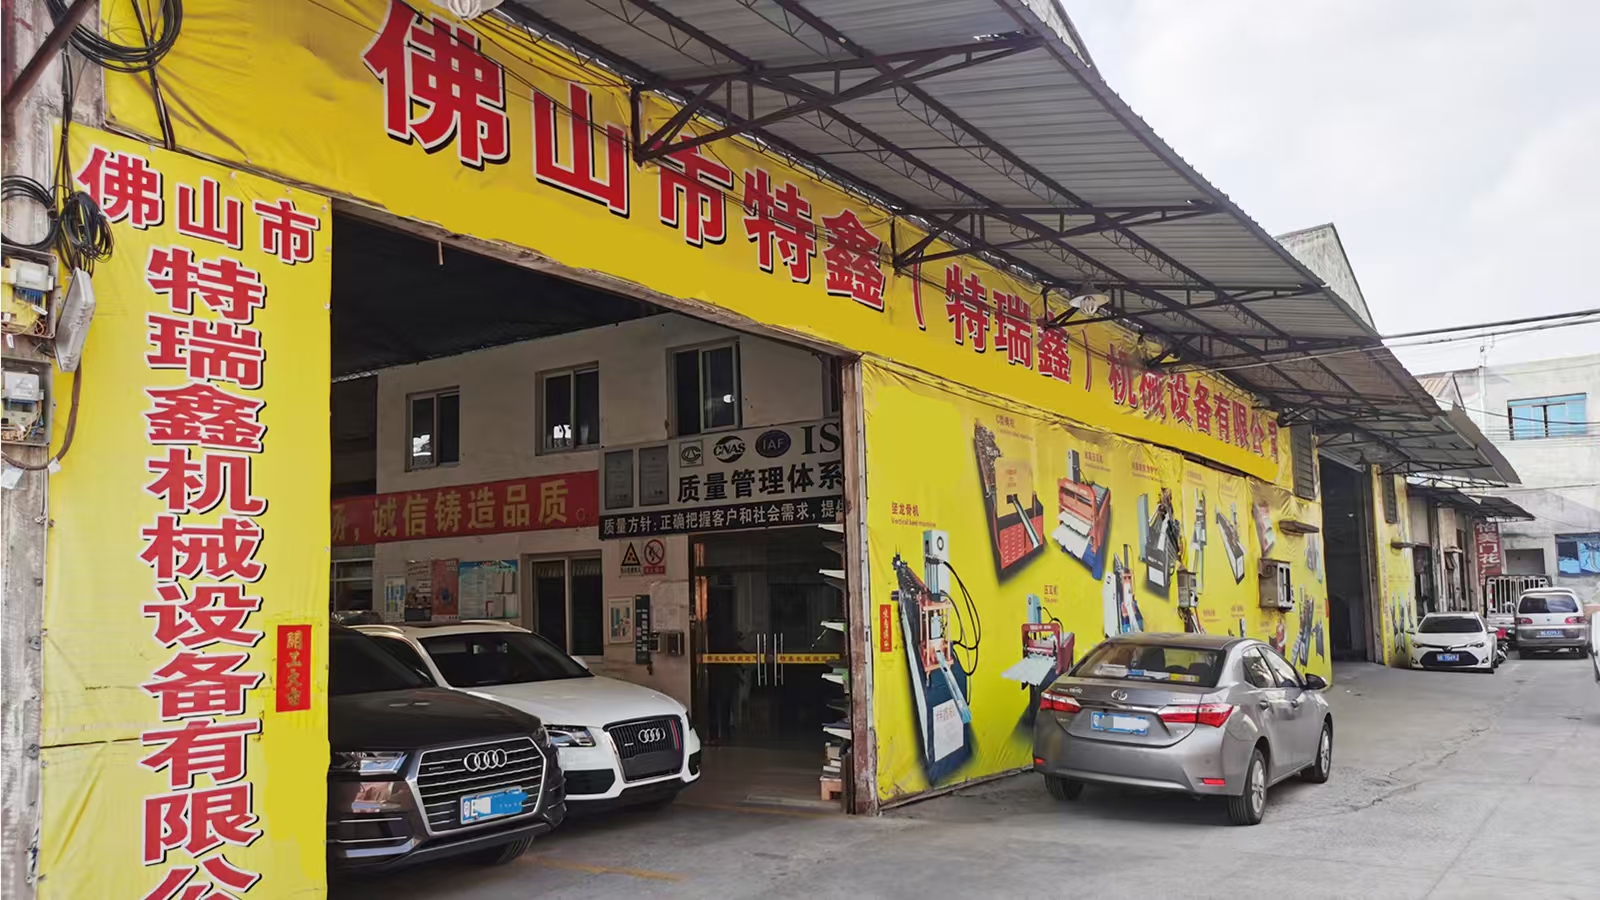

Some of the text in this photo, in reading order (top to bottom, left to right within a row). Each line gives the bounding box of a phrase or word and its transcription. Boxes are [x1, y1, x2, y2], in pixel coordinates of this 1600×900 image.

[77, 145, 318, 264] 佛山市
[713, 442, 746, 456] CNAS
[763, 437, 785, 450] IAF
[677, 460, 842, 504] 质量管理体系
